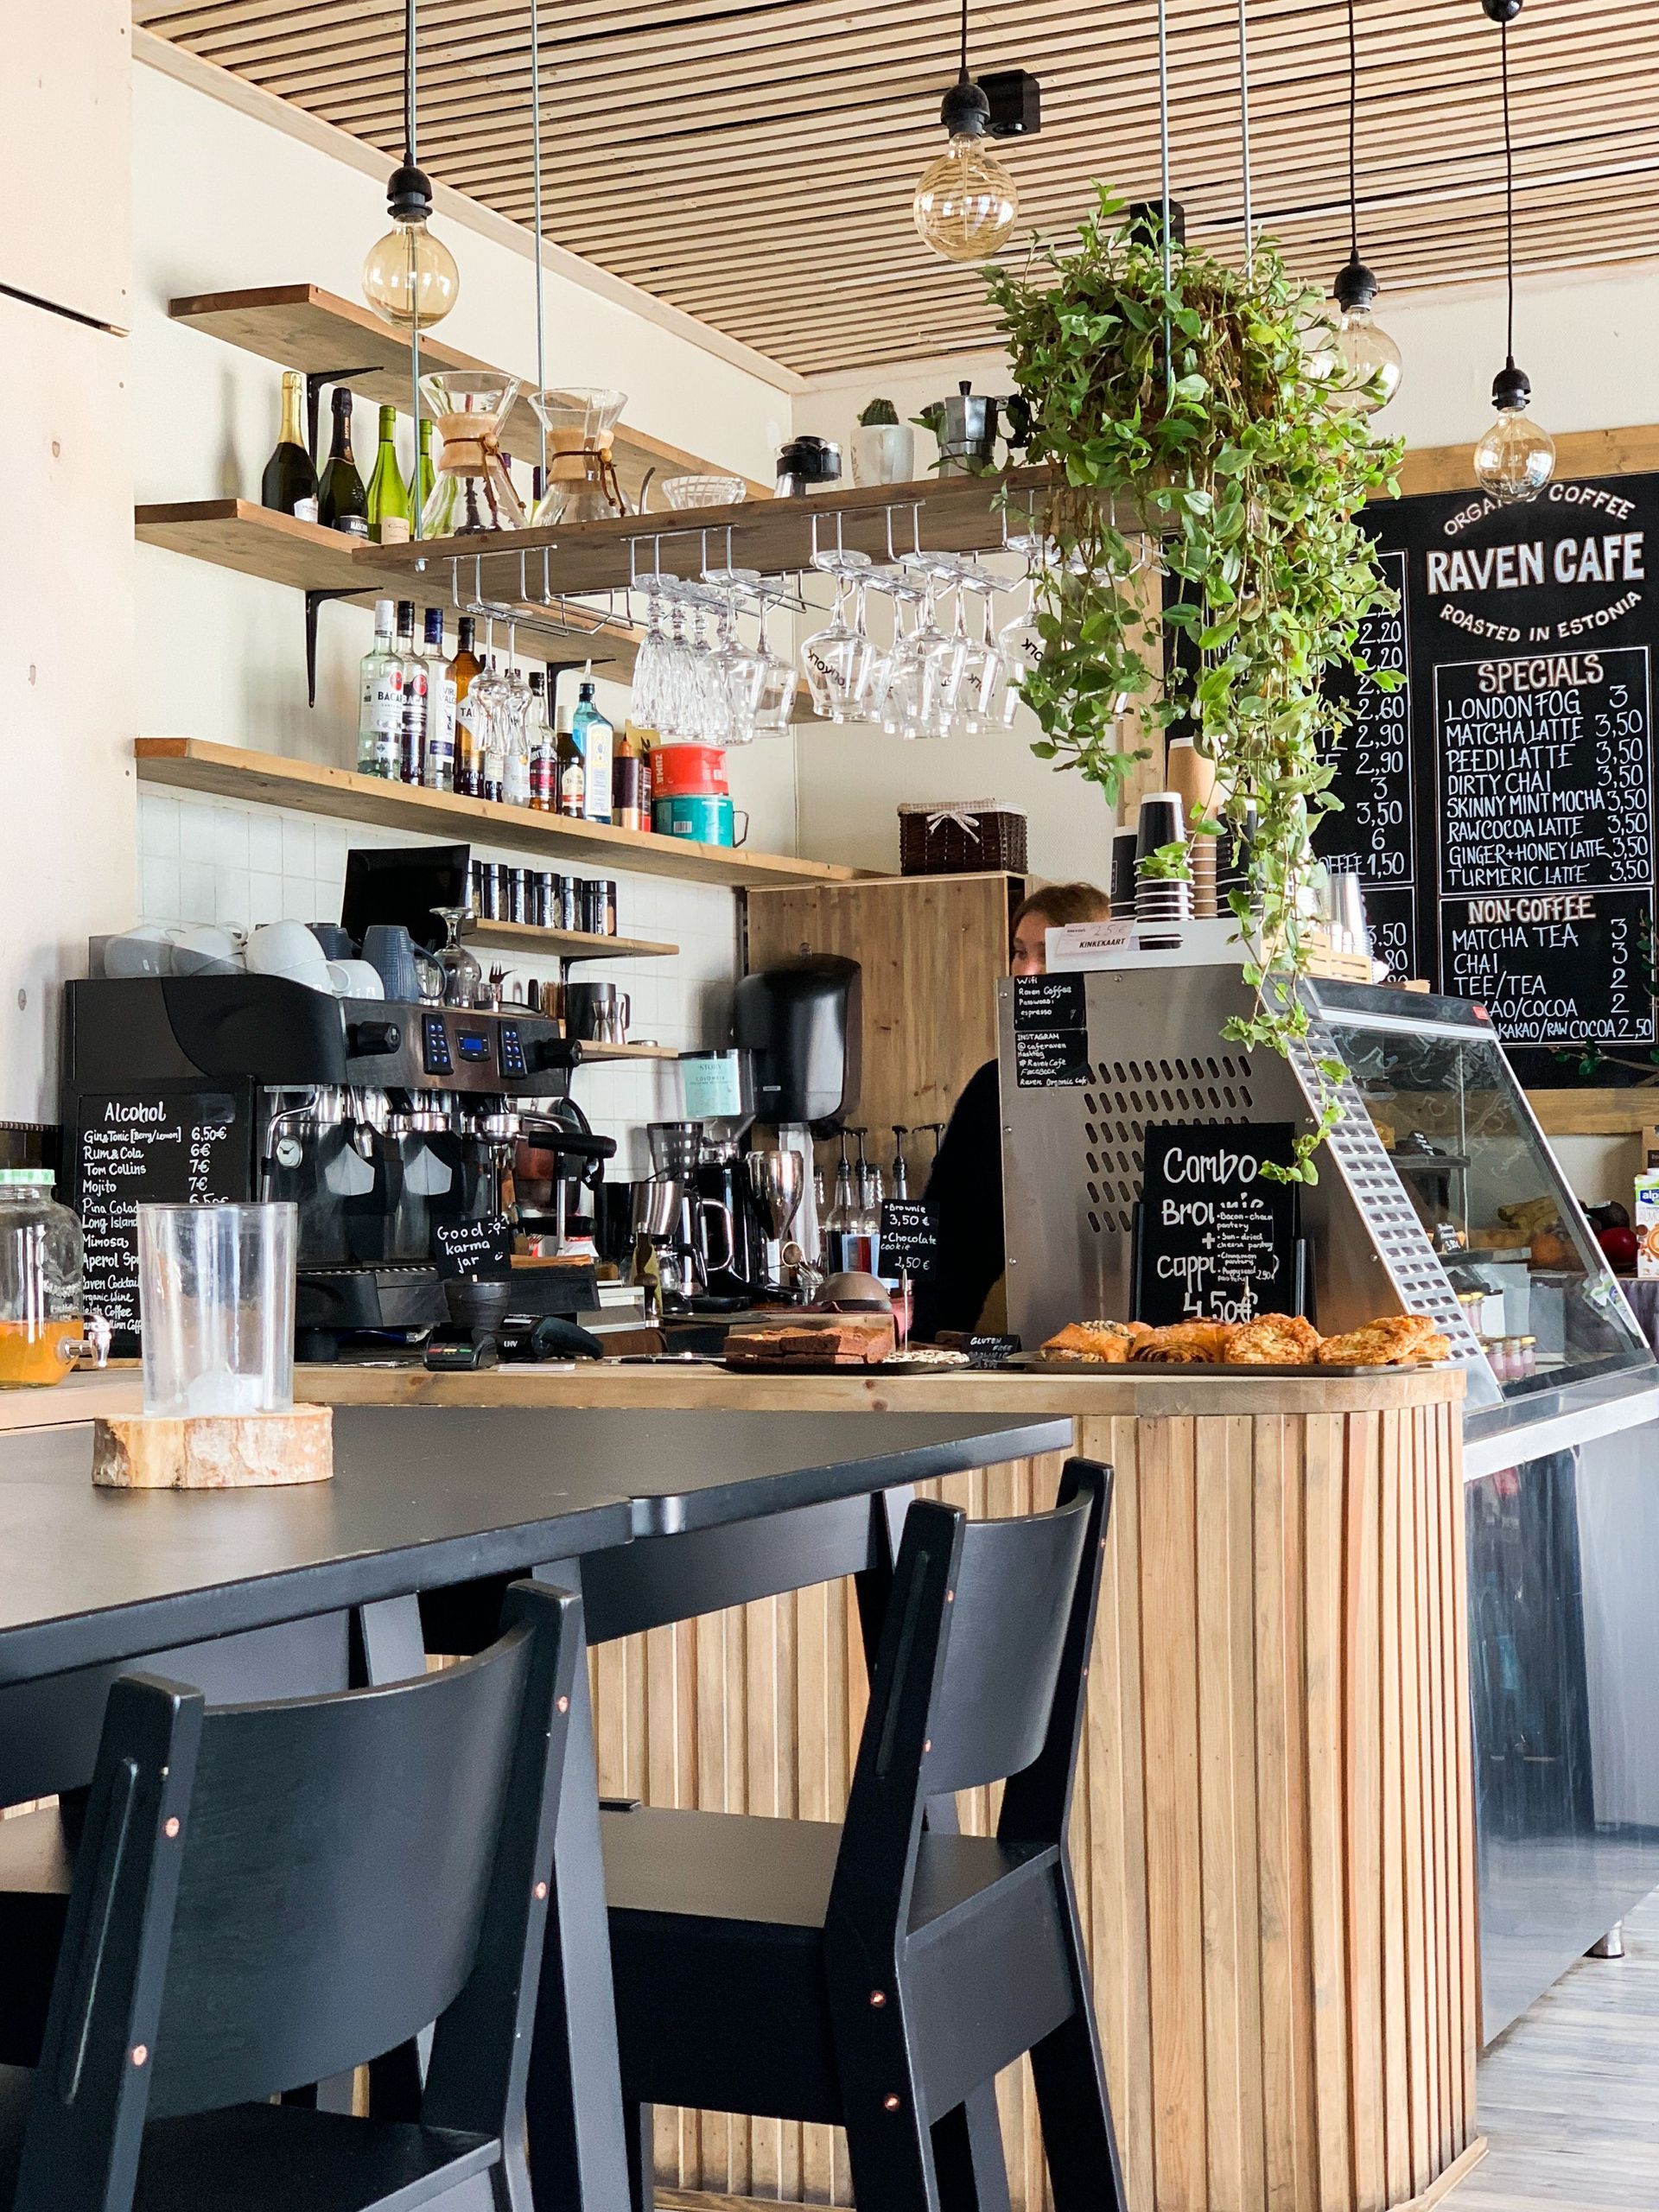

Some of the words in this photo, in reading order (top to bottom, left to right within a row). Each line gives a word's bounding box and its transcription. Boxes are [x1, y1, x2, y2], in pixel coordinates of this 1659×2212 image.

[1443, 496, 1537, 536] ORGA
[1548, 484, 1636, 520] COFFEE
[1426, 541, 1545, 595] RAVEN
[1554, 531, 1645, 584] CAFE
[1440, 603, 1521, 643] ROASTED
[1529, 626, 1550, 642] IN
[1557, 591, 1643, 639] ESTONIA
[1358, 620, 1402, 645] 2,20
[1478, 654, 1605, 694] SPECIALS
[1357, 696, 1405, 721] 2,60
[1444, 695, 1532, 722] LONDON
[1535, 689, 1581, 718] FOG
[1609, 684, 1629, 709] 3
[1356, 723, 1404, 749] 2,90
[1446, 719, 1525, 747] MATCHA
[1526, 716, 1584, 745] LATTE
[1595, 709, 1643, 738] 3,50
[1355, 751, 1404, 776] 2,90
[1445, 747, 1505, 773] PEEDI
[1507, 744, 1576, 772] LATTE
[1596, 738, 1643, 765] 3,50
[655, 753, 664, 785] ZUMA
[1447, 774, 1502, 796] DIRTY
[1505, 770, 1551, 794] CHAI
[1598, 764, 1643, 789] 3,50
[1370, 777, 1388, 800] 3
[1357, 800, 1403, 826] 3,50
[1446, 795, 1506, 818] SKINNY
[1510, 791, 1551, 816] MINT
[1553, 788, 1605, 813] MOCHA
[1606, 788, 1648, 814] 3,50
[1538, 816, 1584, 838] LATTE
[1606, 812, 1649, 836] 3,50
[1371, 828, 1386, 851] 6
[1570, 837, 1613, 860] LATTE
[1612, 836, 1649, 859] 3,50
[1316, 851, 1367, 876] OFFEE
[1367, 851, 1405, 880] 1,50
[1446, 866, 1541, 887] TURMERIC
[1545, 863, 1591, 885] LATTE
[1609, 859, 1649, 881] 3,50
[1467, 893, 1597, 925] NON-COFFEE
[1079, 938, 1126, 949] KINKEKAART
[1452, 926, 1529, 951] MATCHA
[1532, 923, 1580, 948] TEA
[1610, 918, 1628, 940] 3
[1453, 952, 1499, 975] CHAI
[1611, 941, 1629, 964] 3
[1018, 988, 1040, 996] Raven
[1043, 985, 1072, 999] Coffee
[1453, 970, 1547, 999] TEE/TEA
[1610, 968, 1629, 989] 2
[1020, 1009, 1052, 1018] espresso
[1610, 993, 1630, 1014] 2
[1569, 1018, 1616, 1039] COCOA
[1618, 1017, 1652, 1040] 2,50
[104, 1101, 167, 1122] Alcohol
[191, 1126, 227, 1142] 6,50€
[190, 1142, 211, 1157] 6€
[84, 1163, 106, 1176] Tom
[108, 1161, 147, 1175] Collins
[188, 1159, 211, 1173] 7€
[1163, 1147, 1258, 1184] Combo
[82, 1179, 117, 1197] Mojito
[188, 1176, 208, 1192] 7€
[82, 1197, 107, 1214] Pina
[109, 1199, 139, 1214] Colad
[889, 1203, 926, 1213] Brownie
[81, 1214, 108, 1235] Long
[437, 1222, 484, 1241] Good
[889, 1214, 919, 1226] 3,50
[82, 1233, 130, 1249] Mimosa
[445, 1240, 491, 1256] karma
[880, 1243, 911, 1251] cookie
[887, 1232, 937, 1245] Chocolate
[83, 1252, 119, 1273] Aperol
[457, 1256, 480, 1274] jar
[894, 1255, 921, 1269] 2,50
[83, 1294, 110, 1306] rganic
[111, 1289, 134, 1303] Wine
[105, 1304, 133, 1319] Coffee
[970, 1337, 1002, 1345] GLUTEN
